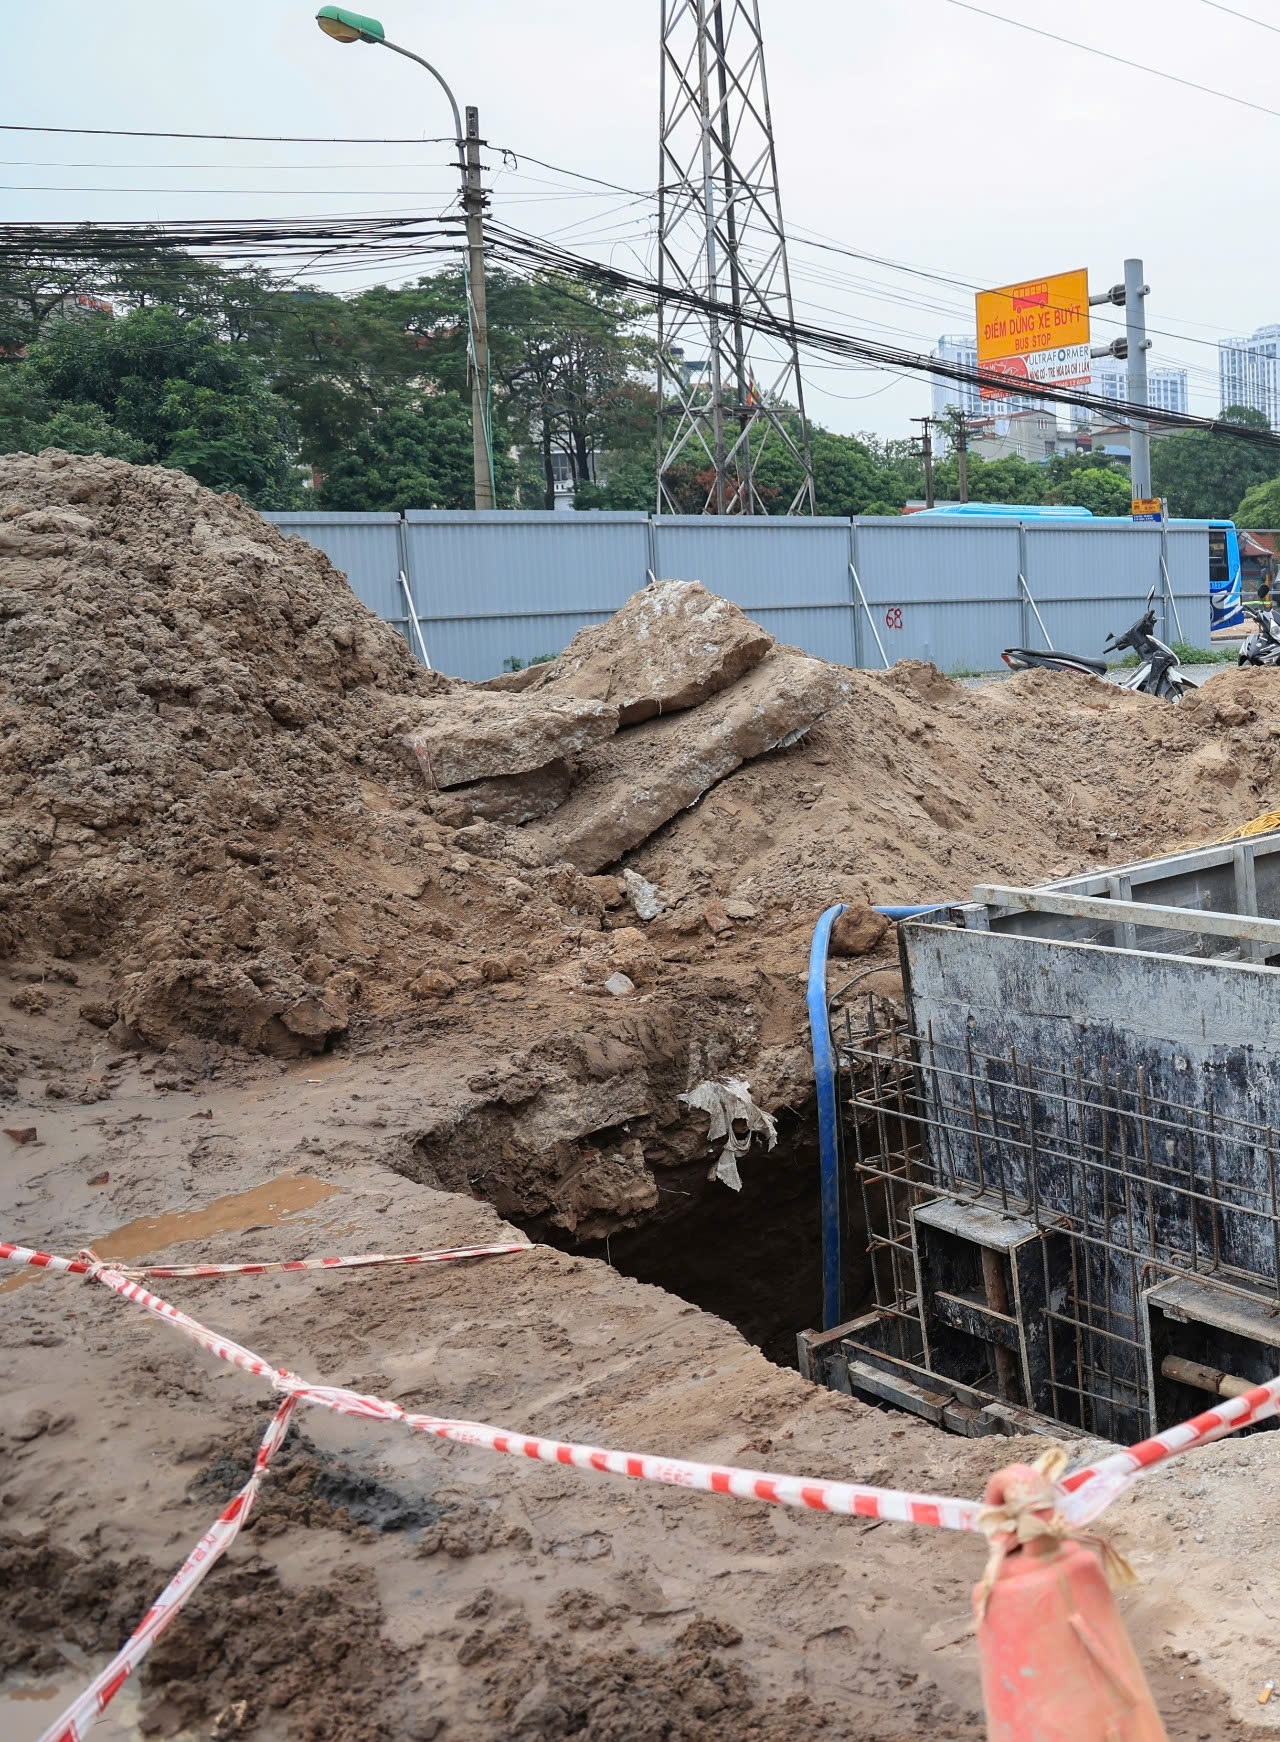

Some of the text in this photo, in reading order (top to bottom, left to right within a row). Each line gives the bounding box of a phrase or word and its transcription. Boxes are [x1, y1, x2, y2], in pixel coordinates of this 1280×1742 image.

[984, 304, 1080, 340] ĐIỂM DỪNG XE BUÝT
[1015, 333, 1052, 351] BUS STOP
[1029, 346, 1088, 365] ULTRAFORMER
[886, 608, 903, 629] 68
